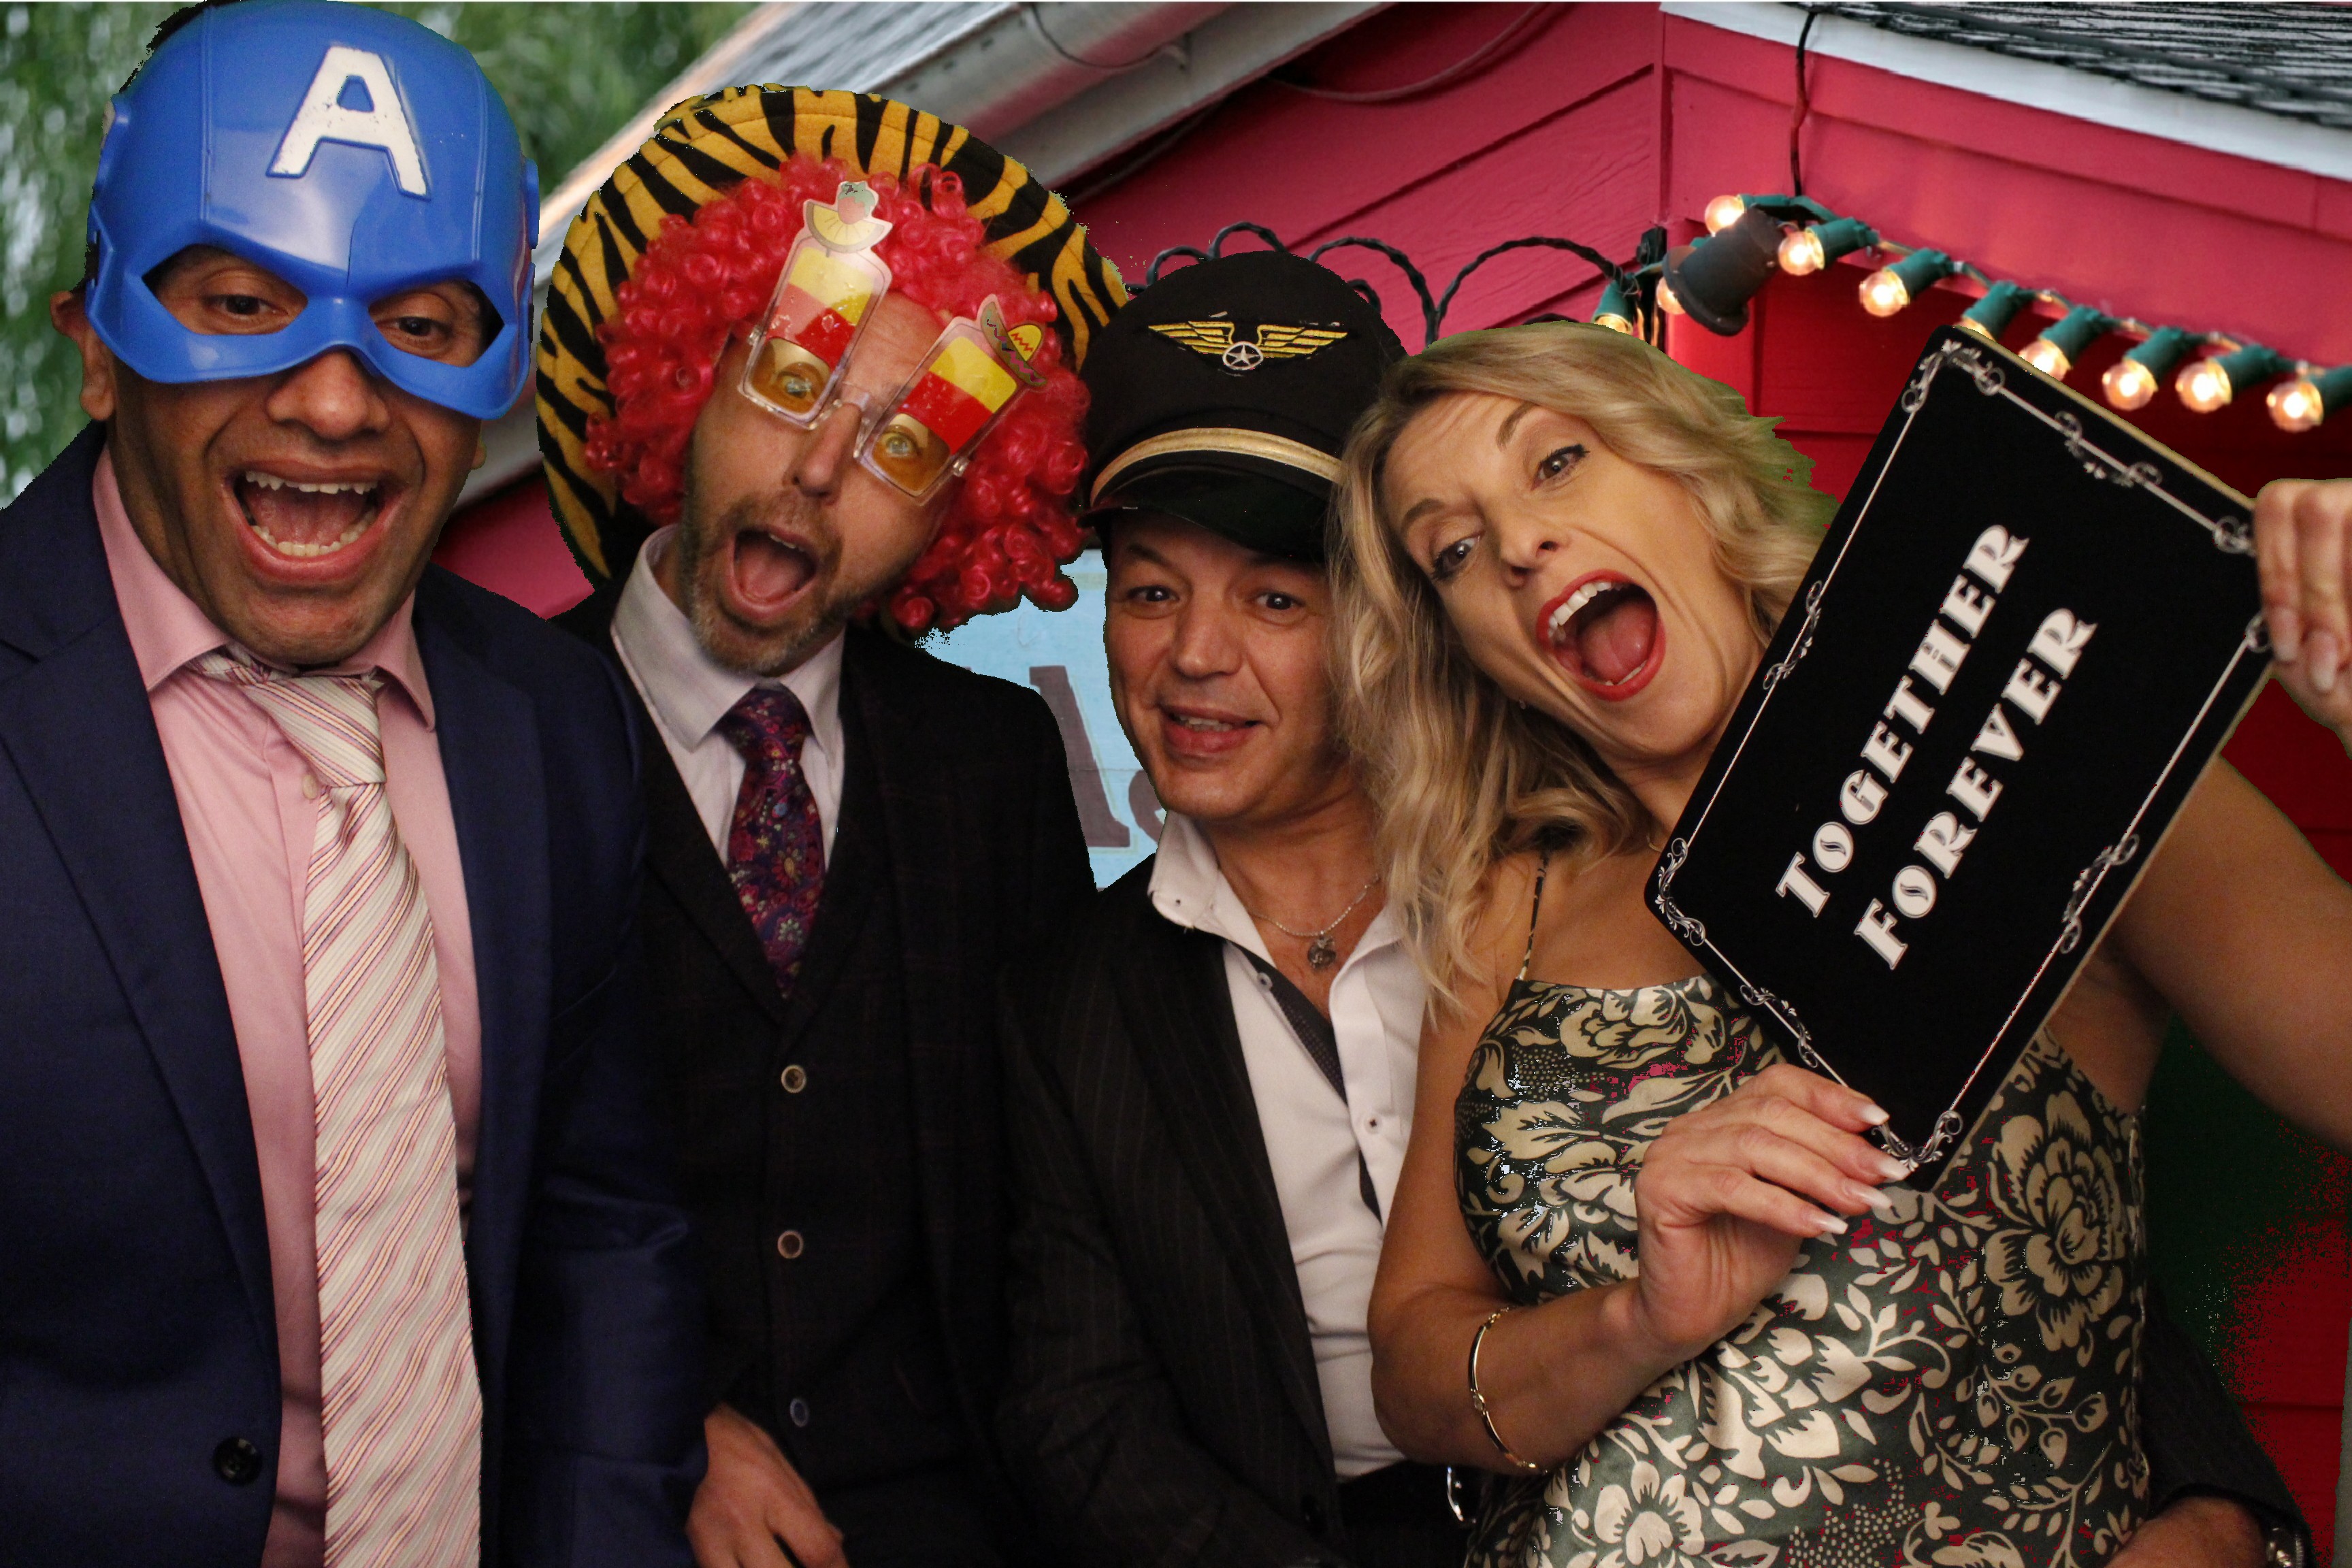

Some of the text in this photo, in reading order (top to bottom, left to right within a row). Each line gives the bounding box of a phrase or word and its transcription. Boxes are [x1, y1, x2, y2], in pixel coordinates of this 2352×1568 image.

[267, 46, 431, 201] A
[1776, 524, 2030, 919] TOGETHER
[1852, 607, 2098, 971] FOREVER
